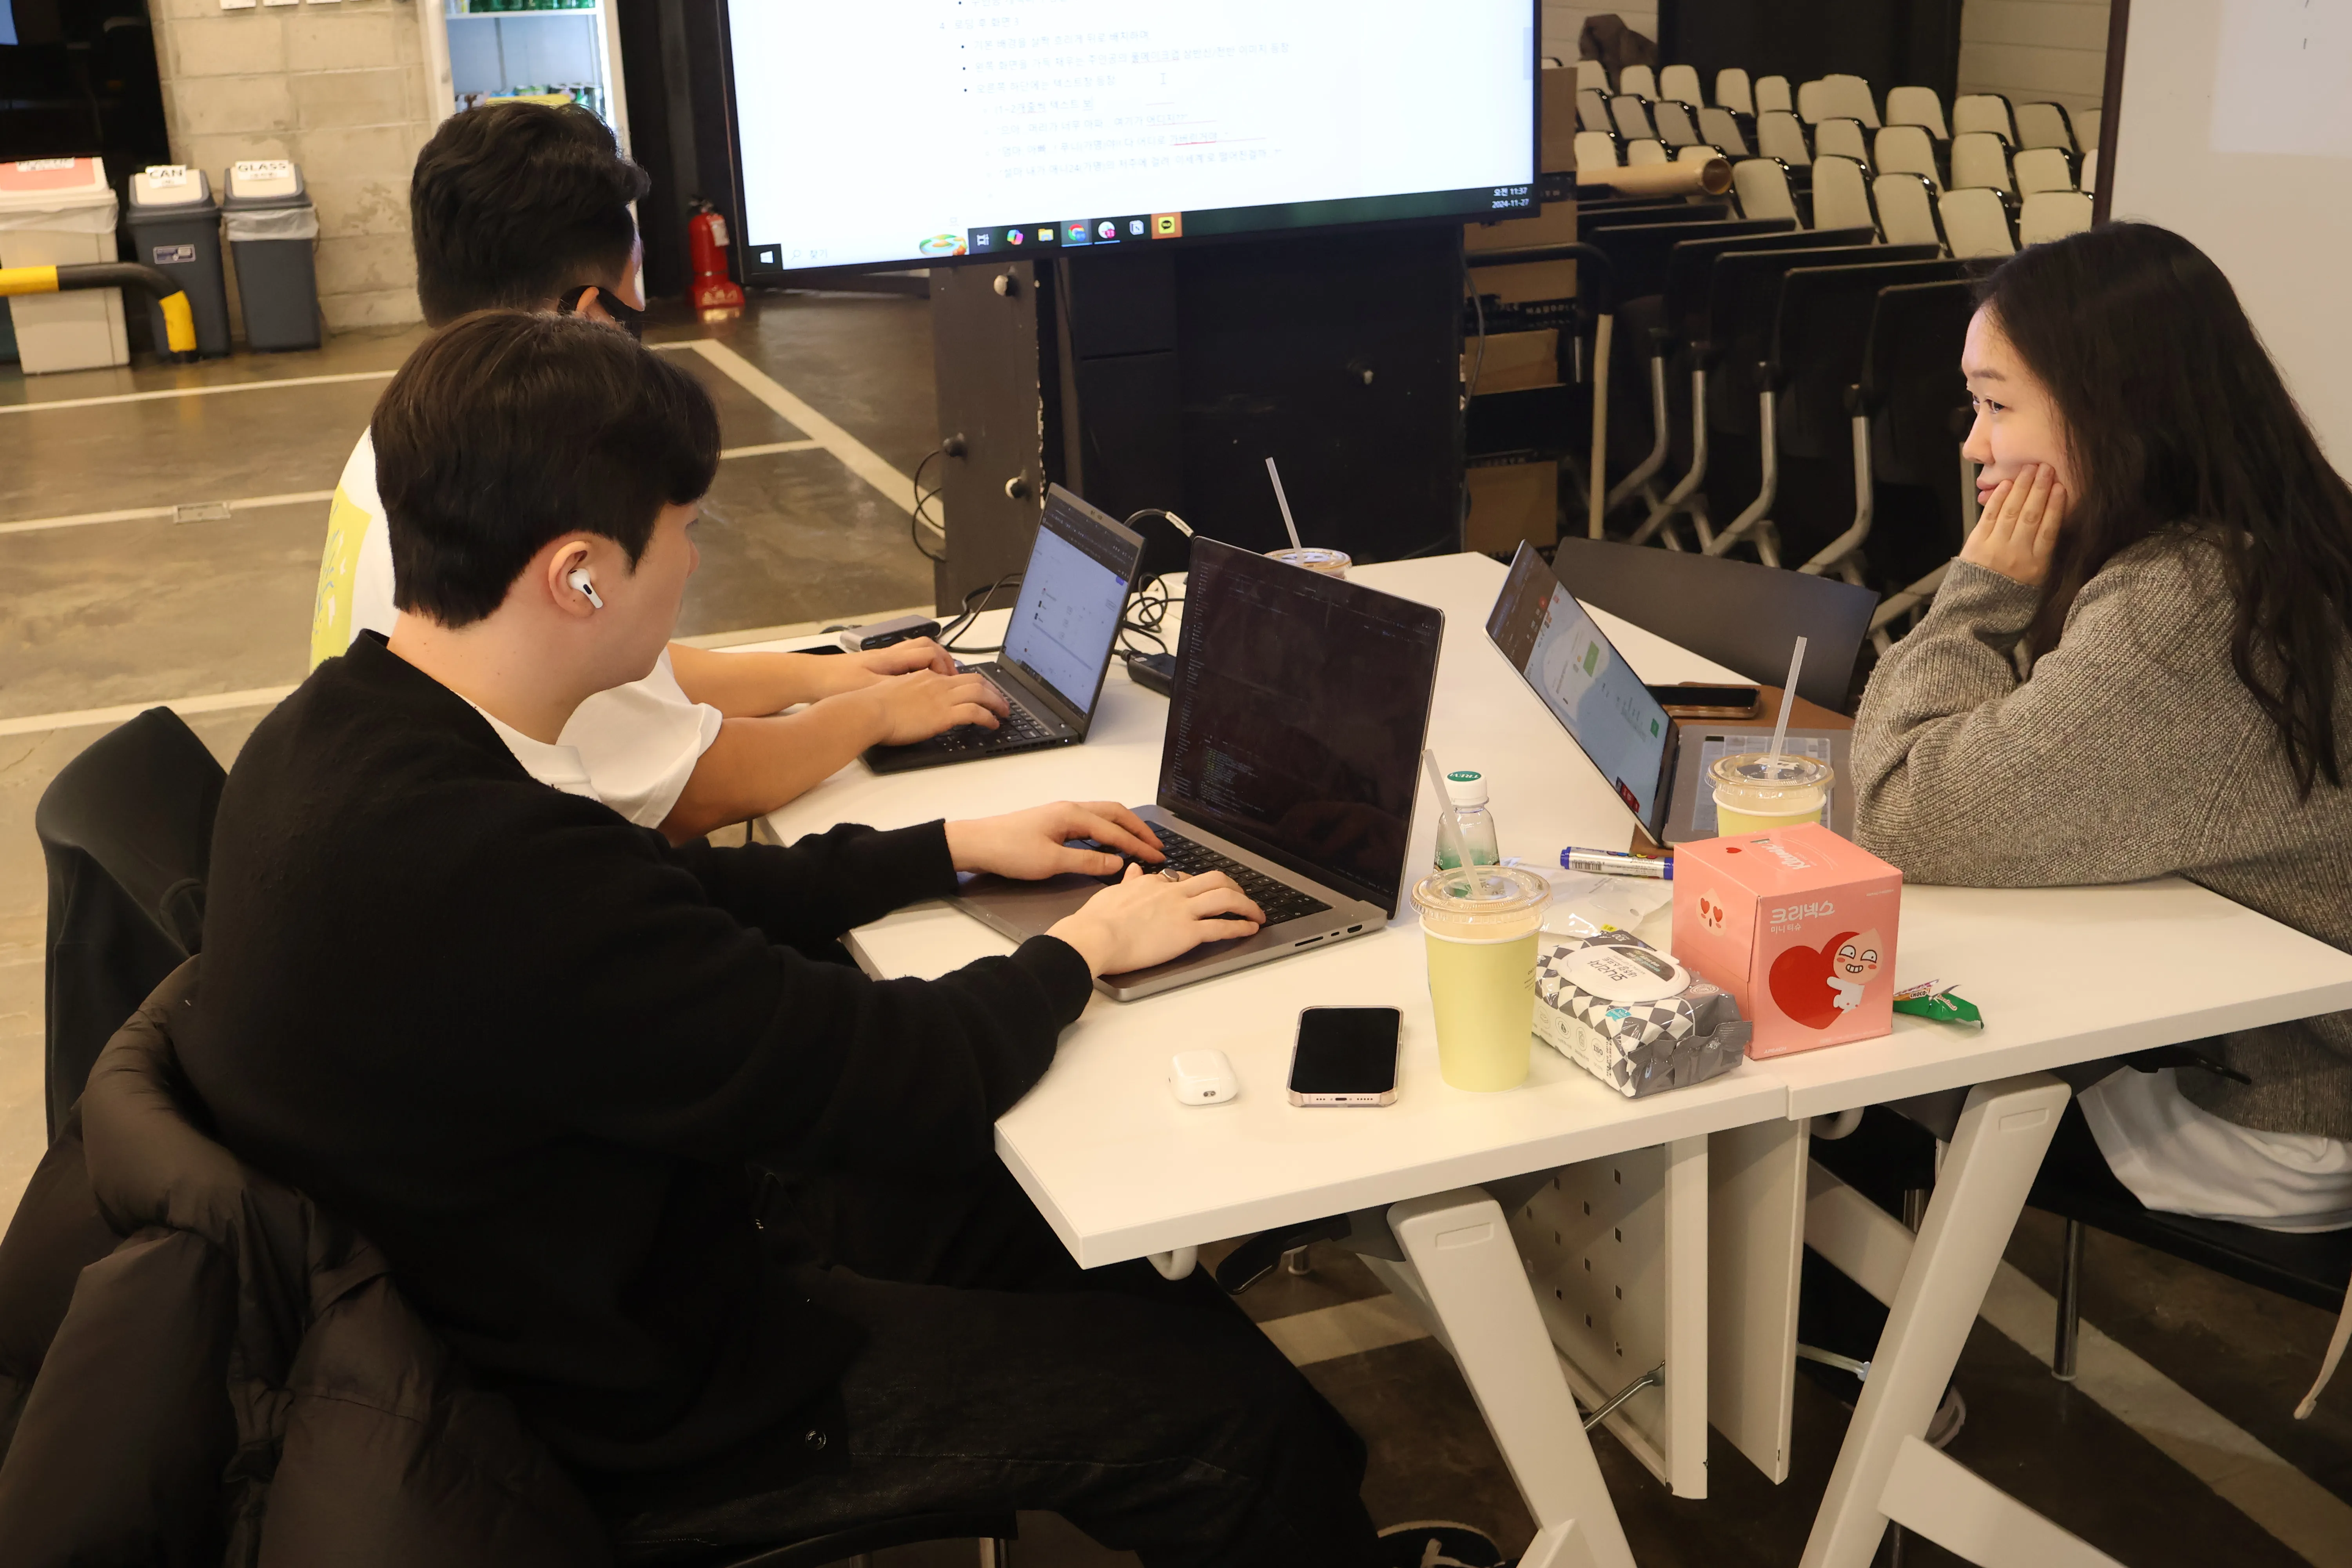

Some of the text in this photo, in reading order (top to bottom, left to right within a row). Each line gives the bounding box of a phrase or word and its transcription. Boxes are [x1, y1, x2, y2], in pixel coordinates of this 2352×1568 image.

[955, 18, 974, 30] 로딩
[991, 17, 1010, 28] 화면
[974, 40, 993, 51] 기본
[999, 59, 1027, 71] 화면을
[1089, 52, 1127, 65] 주인공의
[150, 169, 182, 179] CAN
[1493, 187, 1508, 197] 오전
[1491, 198, 1530, 209] 2024-11-27
[1769, 900, 1835, 924] 크리넥스
[1771, 923, 1802, 934] 미니 티슈
[1587, 960, 1628, 981] 모나리자
[1593, 1044, 1603, 1056] ISO
